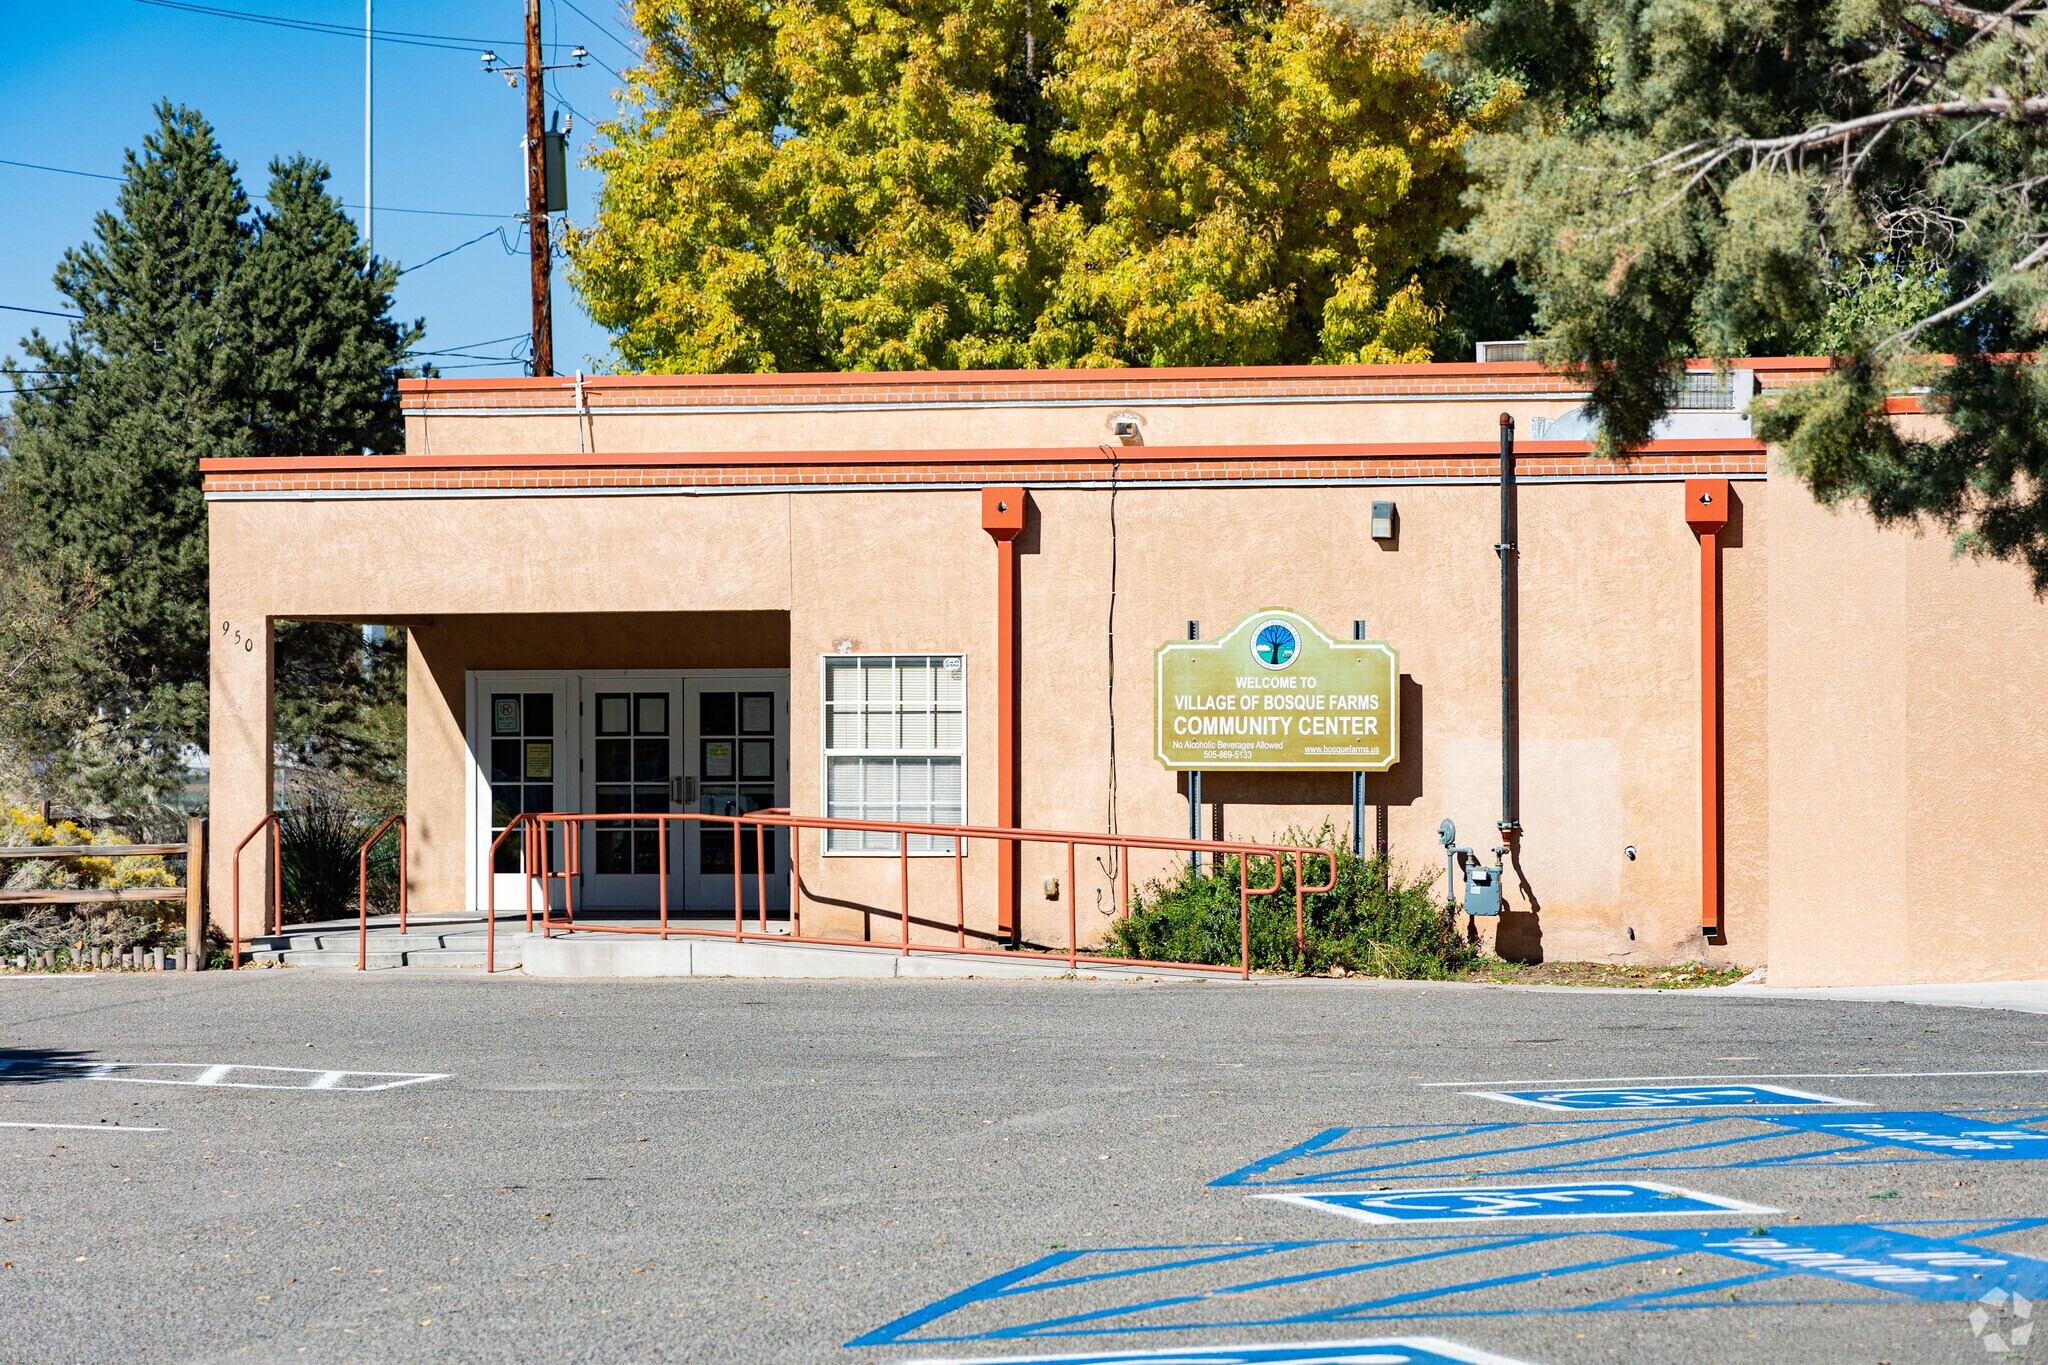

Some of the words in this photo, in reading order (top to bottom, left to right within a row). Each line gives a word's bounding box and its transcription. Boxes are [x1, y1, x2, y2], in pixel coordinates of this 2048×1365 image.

[222, 620, 253, 652] 950
[1236, 676, 1297, 689] WELCOME
[1300, 676, 1317, 689] TO
[1174, 694, 1236, 711] VILLAGE
[1240, 694, 1260, 711] OF
[1264, 694, 1325, 711] BOSQUE
[1329, 694, 1379, 711] FARMS
[1174, 715, 1293, 736] COMMUNITY
[1298, 715, 1379, 736] CENTER
[1172, 740, 1183, 749] No
[1184, 740, 1216, 749] Alcoholic
[1217, 741, 1255, 751] Beverages
[1256, 740, 1284, 750] Allowed
[1304, 745, 1380, 755] www.bosquefarms.us
[1203, 750, 1253, 759] 505-869-5133
